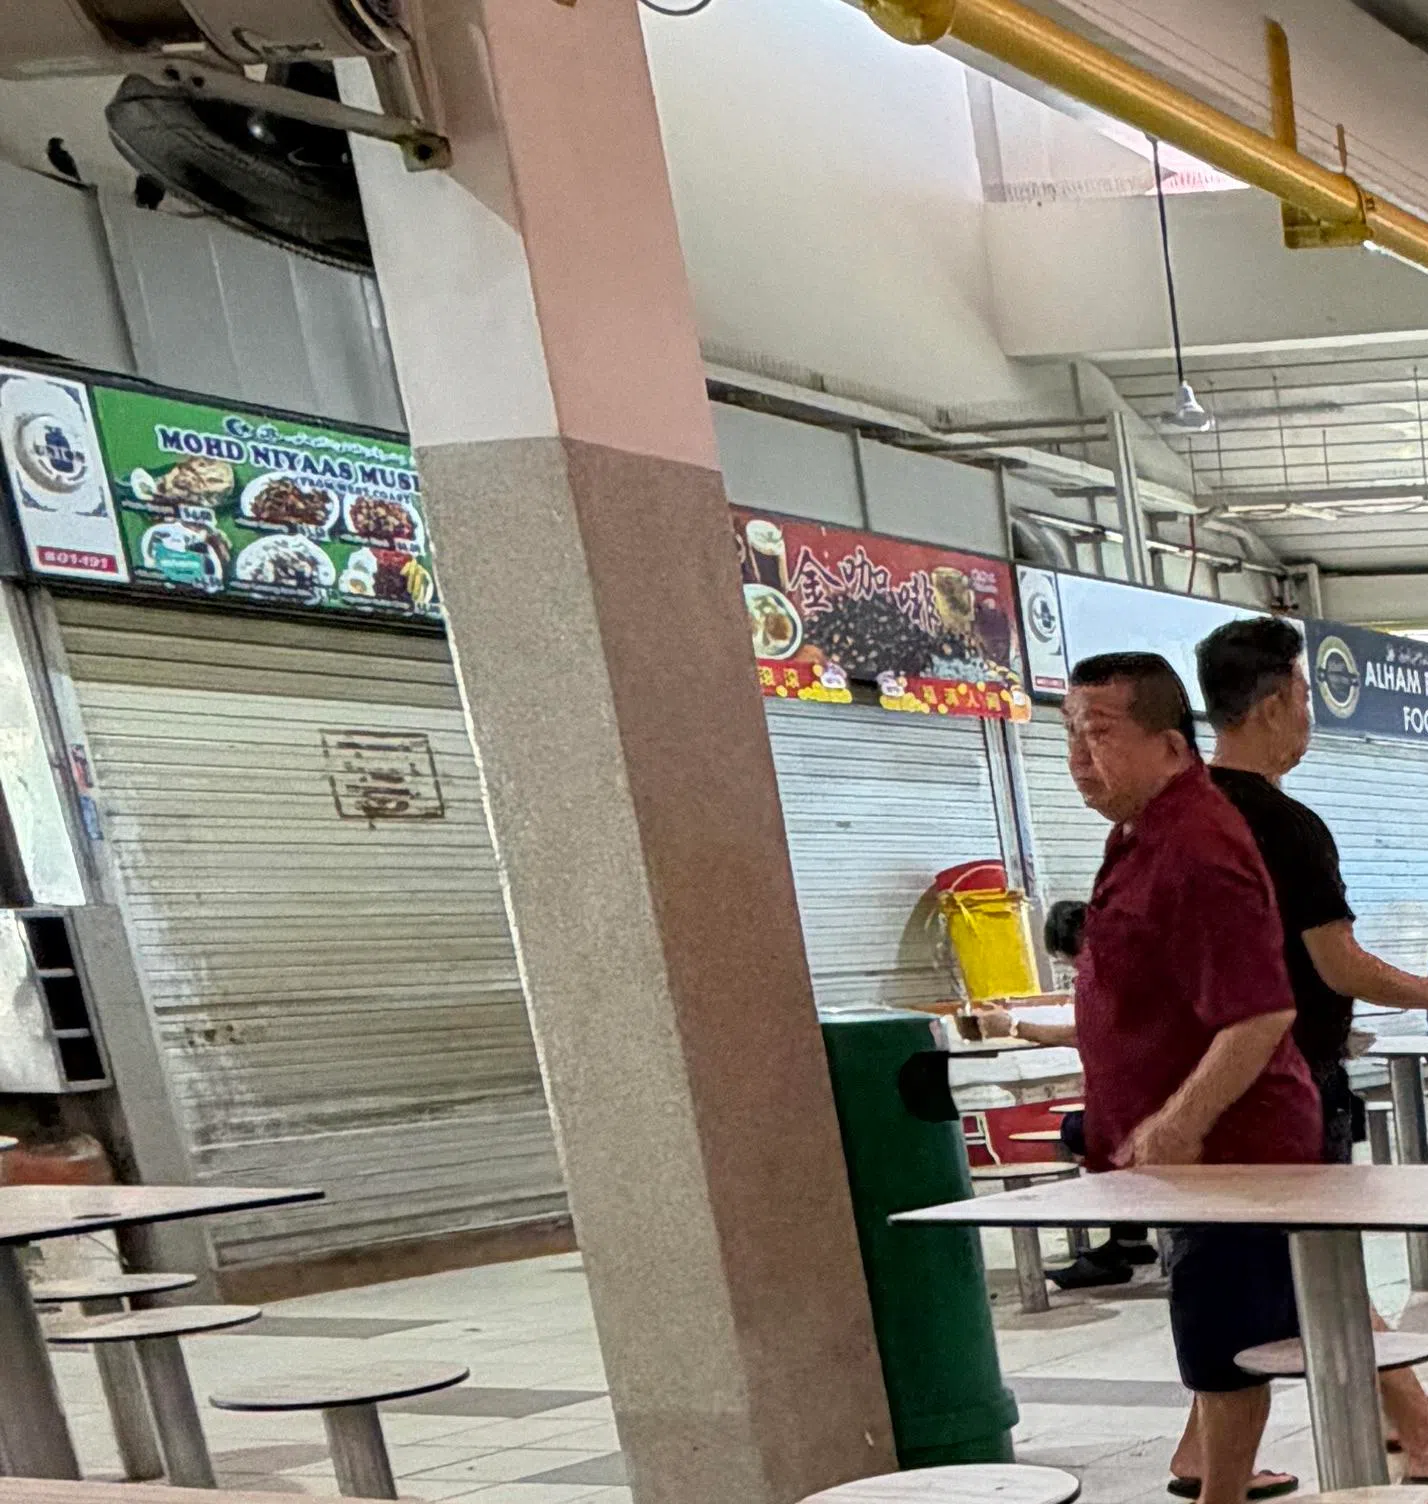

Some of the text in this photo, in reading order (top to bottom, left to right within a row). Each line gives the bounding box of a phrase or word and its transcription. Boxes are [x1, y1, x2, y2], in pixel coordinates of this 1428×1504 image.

[158, 427, 243, 463] MOHD
[251, 447, 352, 483] NIYAAS
[1365, 661, 1421, 694] ALHAM
